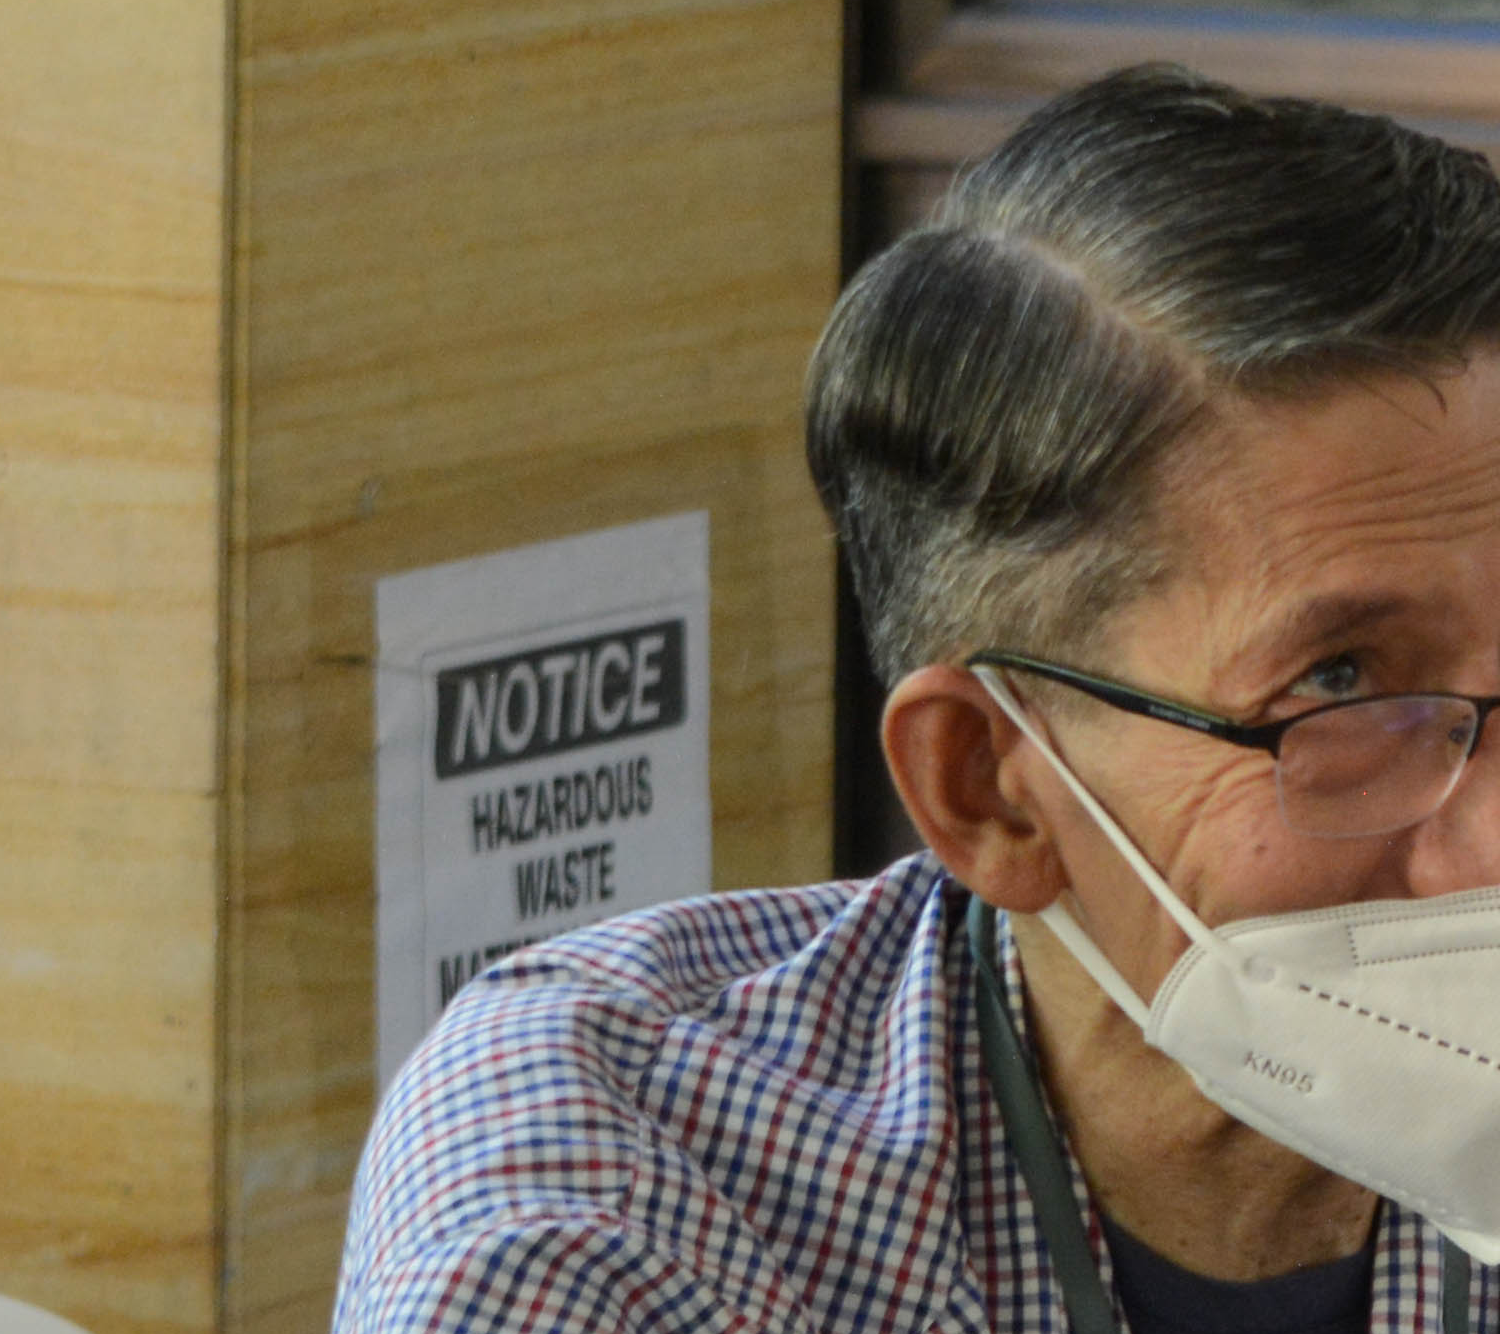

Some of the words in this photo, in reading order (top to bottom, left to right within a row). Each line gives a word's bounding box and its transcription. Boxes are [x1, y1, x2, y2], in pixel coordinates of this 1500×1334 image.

[452, 634, 666, 766] NOTICE
[471, 755, 654, 854] HAZARDOUS
[516, 839, 616, 921] WASTE
[1242, 1050, 1314, 1093] KN95
